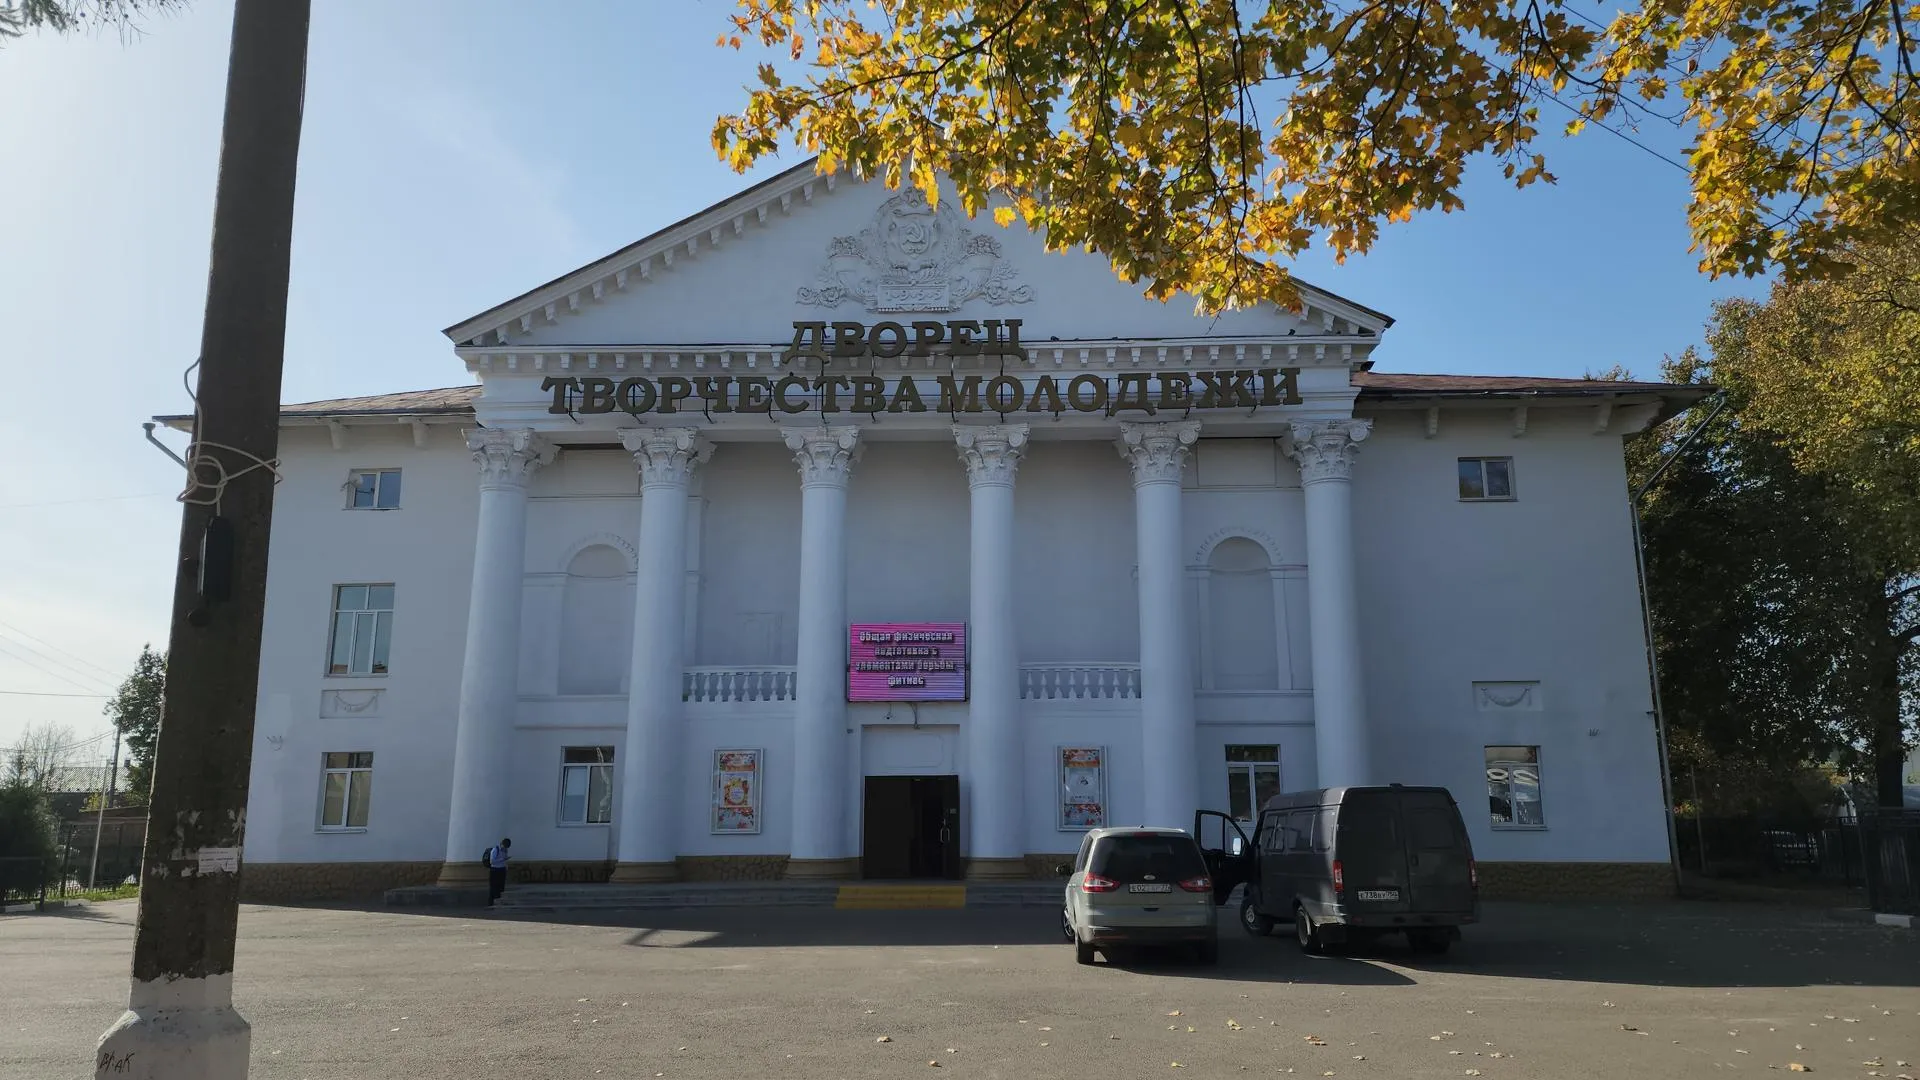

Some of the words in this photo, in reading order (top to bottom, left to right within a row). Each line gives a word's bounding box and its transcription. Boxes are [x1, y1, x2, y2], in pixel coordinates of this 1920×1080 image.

[782, 319, 1027, 364] ДВОРЕЦ
[541, 375, 927, 415] ТВОРЧЕСТВА
[936, 368, 1303, 417] МОЛОДЕЖИ
[860, 631, 891, 642] Общая
[887, 675, 924, 687] фитнес
